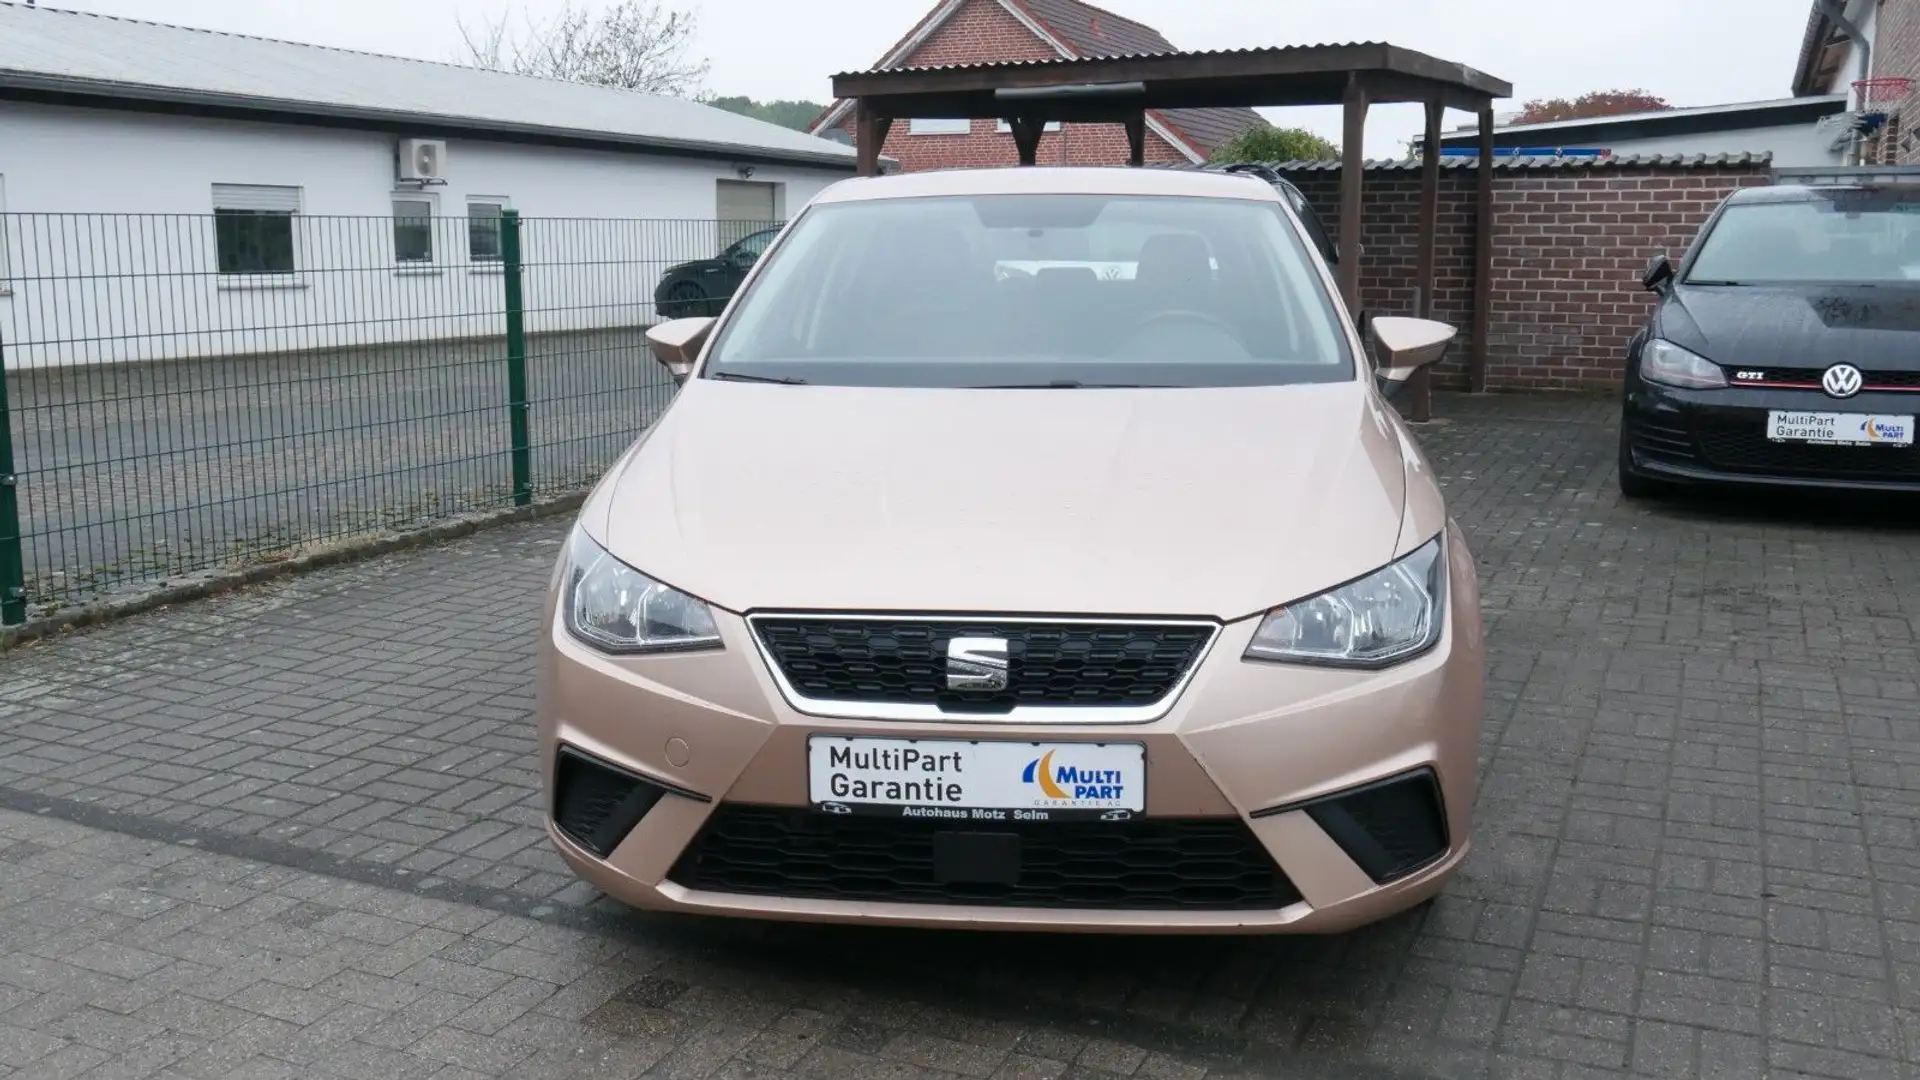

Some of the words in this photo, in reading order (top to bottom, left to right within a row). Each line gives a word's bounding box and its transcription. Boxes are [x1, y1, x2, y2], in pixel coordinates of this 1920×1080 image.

[1736, 371, 1764, 380] GTI
[1777, 415, 1835, 426] MultiPart
[1776, 426, 1834, 438] Garantie
[830, 746, 962, 772] MultiPart
[1056, 766, 1121, 783] MULTI
[830, 773, 962, 801] Garantie
[1075, 785, 1124, 799] PART
[902, 806, 968, 818] Autohaus
[972, 808, 1006, 819] Motz
[1014, 810, 1049, 820] Selm
